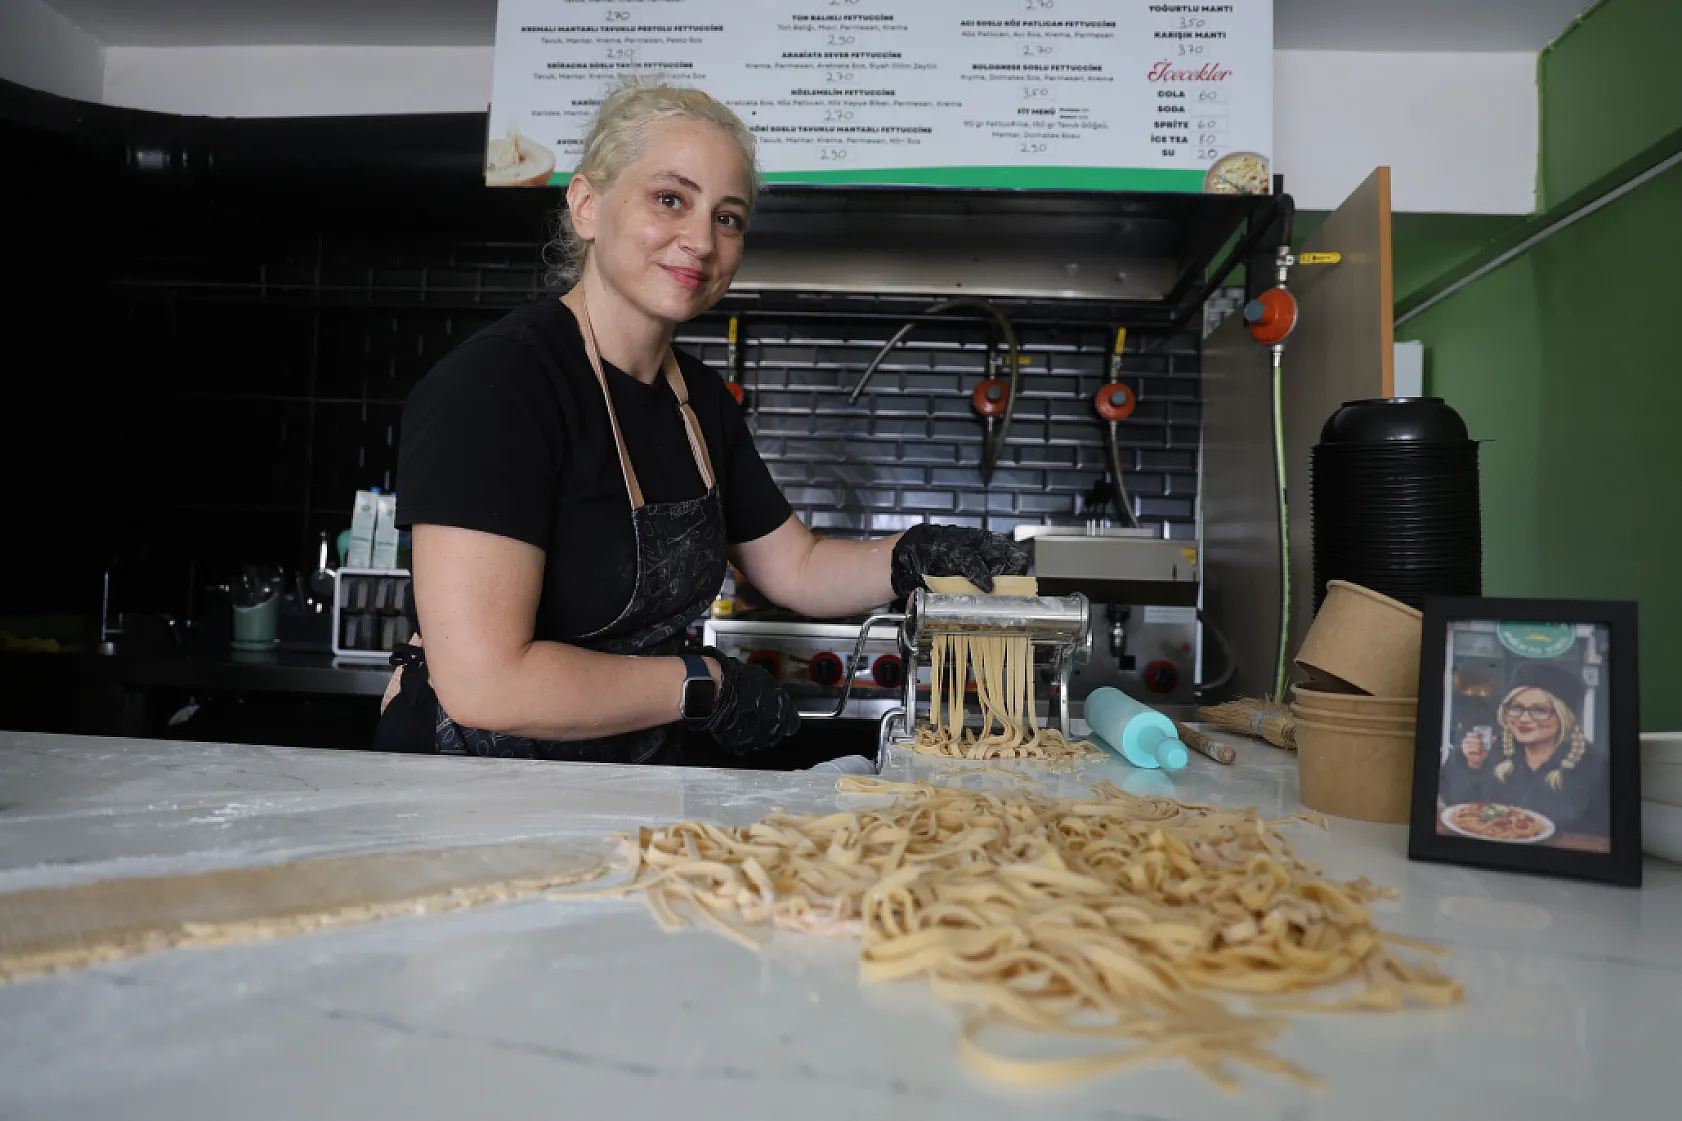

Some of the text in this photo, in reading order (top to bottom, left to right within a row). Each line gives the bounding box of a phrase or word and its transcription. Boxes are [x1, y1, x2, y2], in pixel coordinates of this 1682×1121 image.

[1149, 4, 1198, 12] YOĞURTLU
[1154, 30, 1193, 39] KARIŞIK
[1147, 58, 1234, 82] İçecekler
[1158, 90, 1186, 98] COLA
[1158, 105, 1186, 113] SODA
[1154, 119, 1190, 128] SPRİTE
[1150, 134, 1168, 143] İCE
